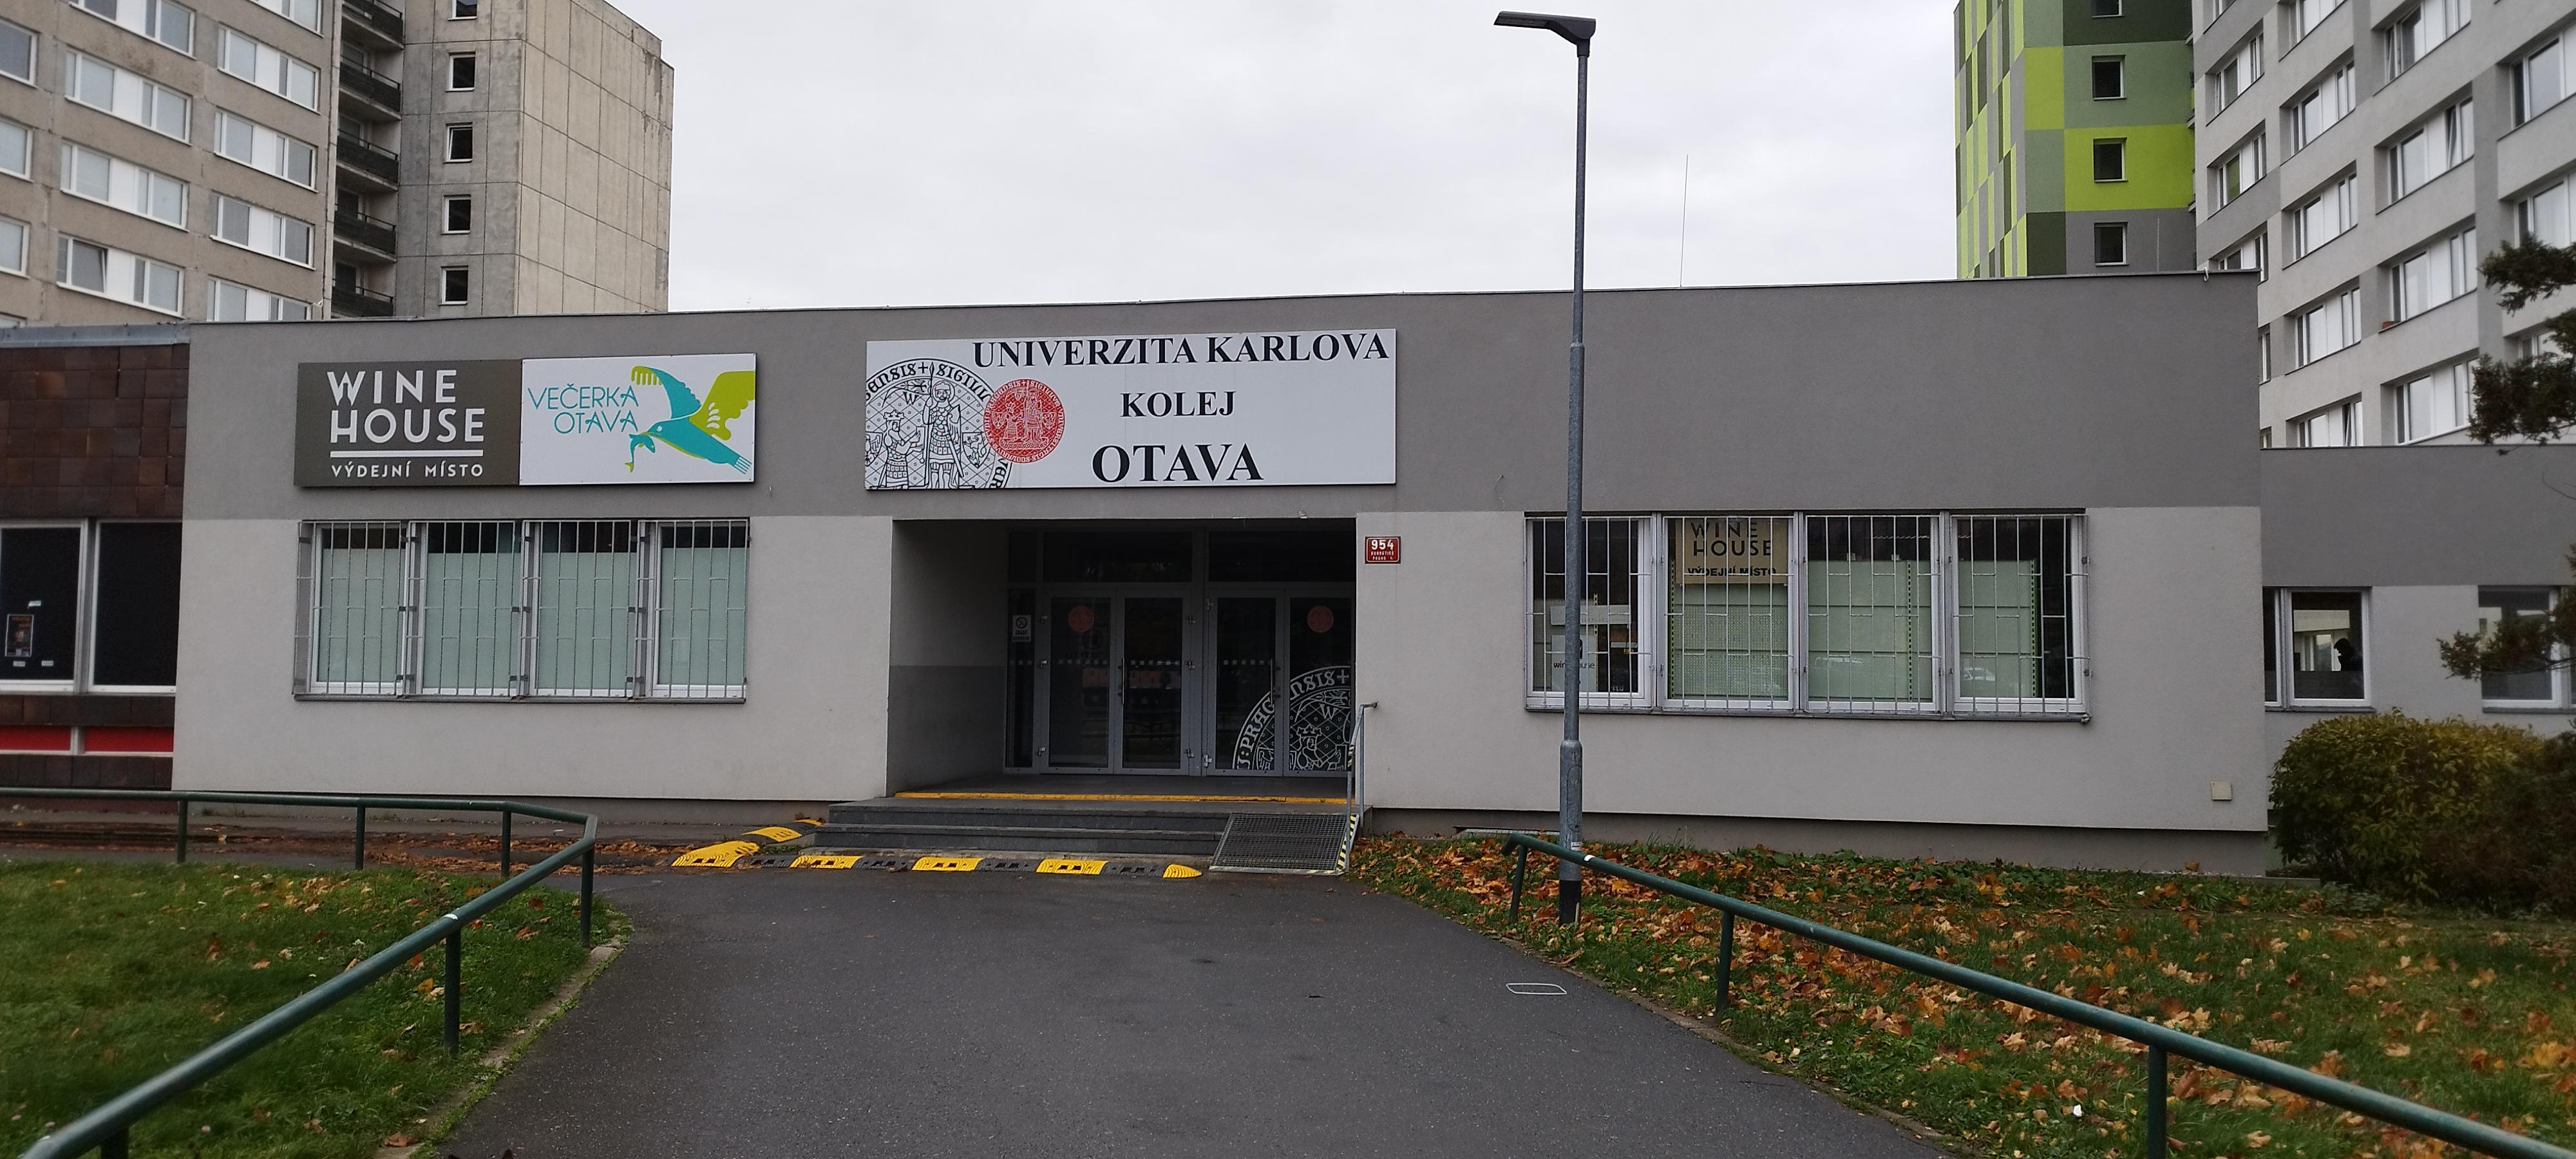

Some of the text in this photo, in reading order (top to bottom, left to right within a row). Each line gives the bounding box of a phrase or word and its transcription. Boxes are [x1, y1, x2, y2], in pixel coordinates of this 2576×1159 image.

[972, 332, 1390, 368] UNIVERZITA KARLOVA
[327, 370, 457, 406] WINE
[527, 383, 639, 409] VEČERKA
[1120, 391, 1236, 417] KOLEJ
[330, 408, 484, 443] HOUSE
[554, 410, 638, 433] OTAVA
[331, 460, 483, 478] VÝDEJNÍ MÍSTO
[1092, 443, 1264, 482] OTAVA
[1690, 522, 1758, 538] WINE
[1371, 539, 1394, 551] 954
[1693, 540, 1774, 556] HOUSE
